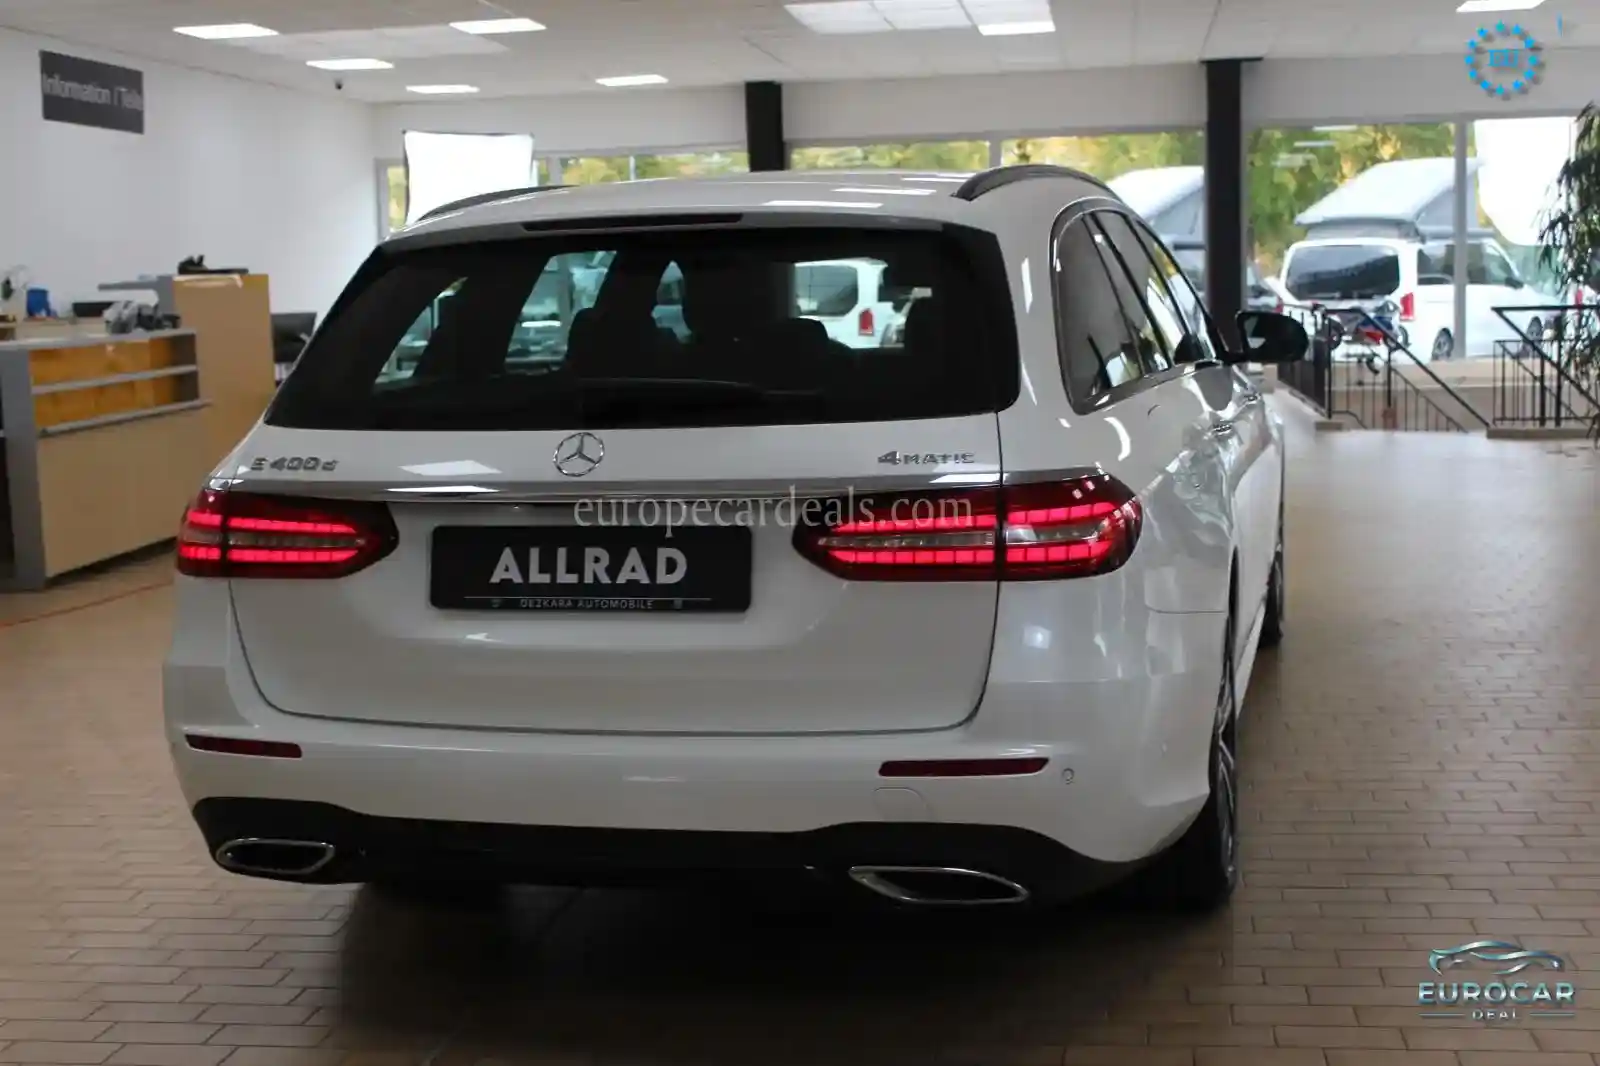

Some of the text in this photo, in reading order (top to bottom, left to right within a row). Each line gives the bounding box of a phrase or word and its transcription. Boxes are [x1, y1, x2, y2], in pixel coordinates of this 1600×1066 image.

[250, 457, 269, 471] E
[877, 450, 976, 466] 4MATIC
[488, 546, 688, 585] ALLRAD
[576, 599, 654, 611] AUTOMOBILE
